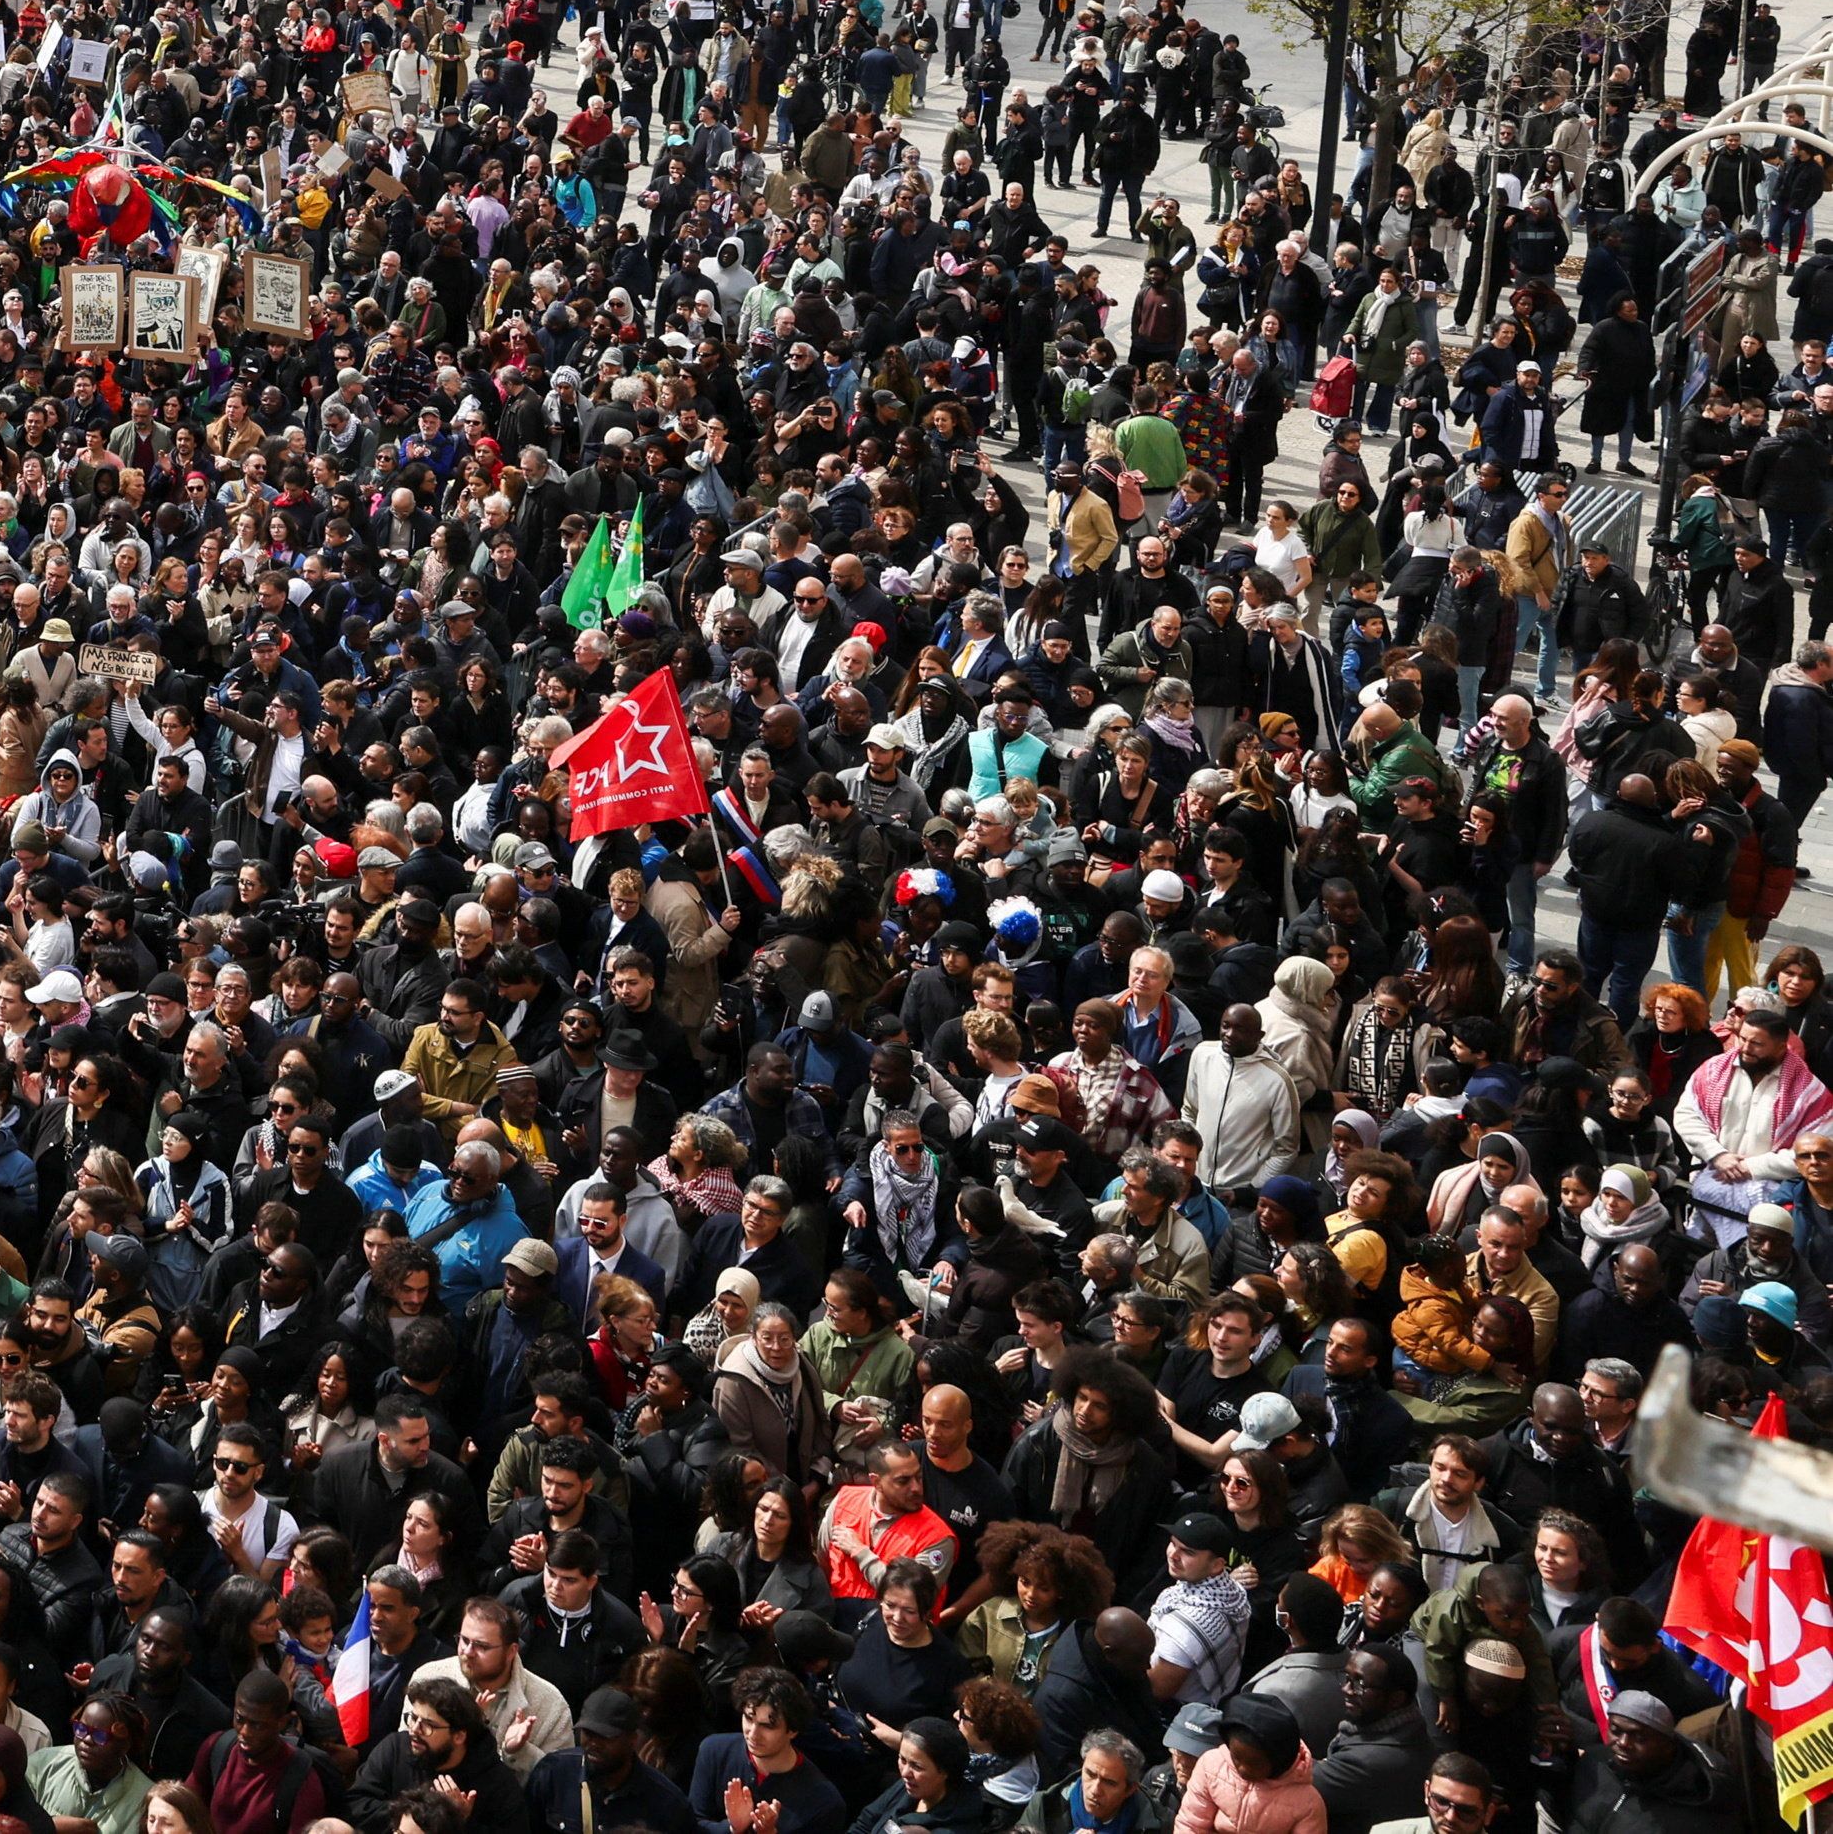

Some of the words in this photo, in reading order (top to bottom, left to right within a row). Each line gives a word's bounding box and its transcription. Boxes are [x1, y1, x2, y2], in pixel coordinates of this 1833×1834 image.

[86, 648, 106, 661] MA
[108, 651, 140, 663] FRANCE
[91, 660, 114, 673] N'EST
